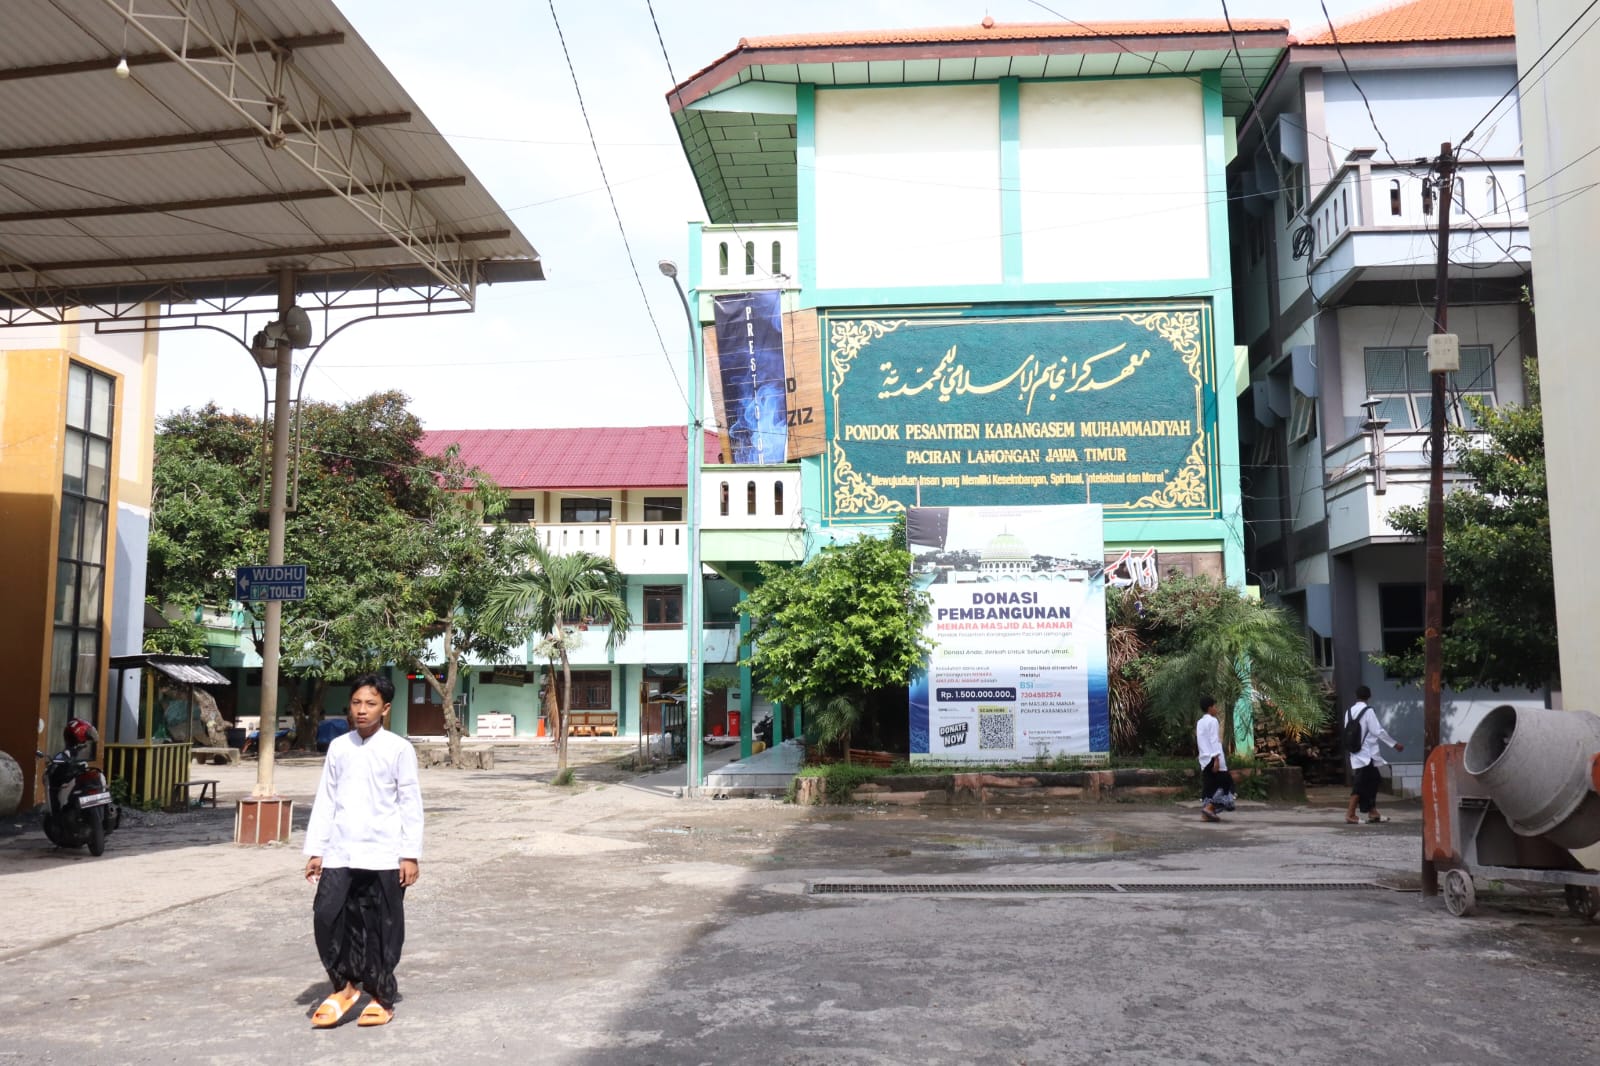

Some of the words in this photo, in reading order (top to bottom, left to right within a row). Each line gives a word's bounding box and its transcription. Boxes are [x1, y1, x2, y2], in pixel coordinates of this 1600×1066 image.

[845, 424, 899, 440] PONDOK
[905, 423, 980, 440] PESANTREN
[985, 421, 1075, 439] KARANGASEM
[1080, 420, 1191, 437] MUHAMMADIYAH
[906, 450, 961, 464] PACIRAN
[967, 449, 1040, 464] LAMONGAN
[1045, 448, 1078, 462] JAWA
[1084, 447, 1127, 461] TIMUR
[941, 476, 960, 489] yang
[961, 474, 992, 485] Memiliki
[1126, 472, 1141, 483] dan
[252, 567, 303, 580] WUDHU
[270, 585, 304, 598] TOILET
[972, 592, 1038, 605] DONASI
[937, 606, 1071, 620] PEMBANGUNAN
[937, 623, 979, 631] MENARA
[980, 622, 1020, 630] MASJID
[1022, 622, 1035, 630] AL
[1036, 621, 1073, 629] MANAR
[940, 691, 954, 700] Rp.
[940, 723, 967, 735] DONATE
[944, 732, 966, 745] NOW
